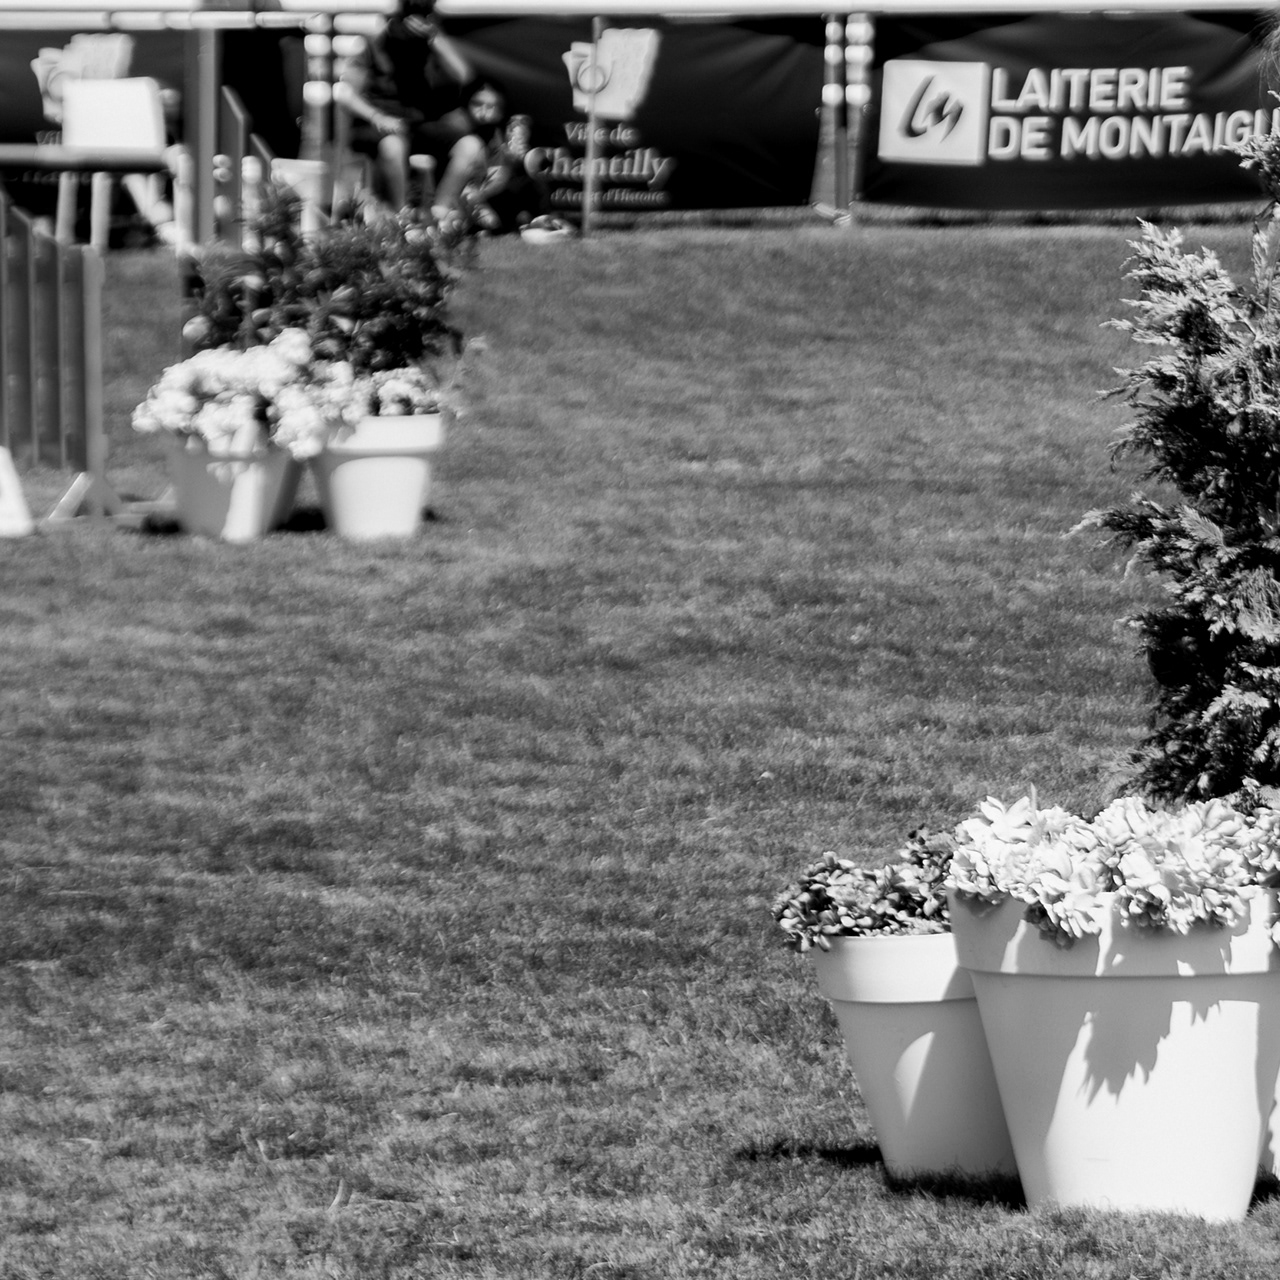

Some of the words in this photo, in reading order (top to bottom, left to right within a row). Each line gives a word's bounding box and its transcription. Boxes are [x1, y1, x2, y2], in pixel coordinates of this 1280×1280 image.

[990, 66, 1191, 113] LAITERIE
[563, 122, 607, 144] Vile
[609, 122, 637, 144] de
[987, 115, 1051, 160] DE
[523, 146, 676, 186] Chantilly
